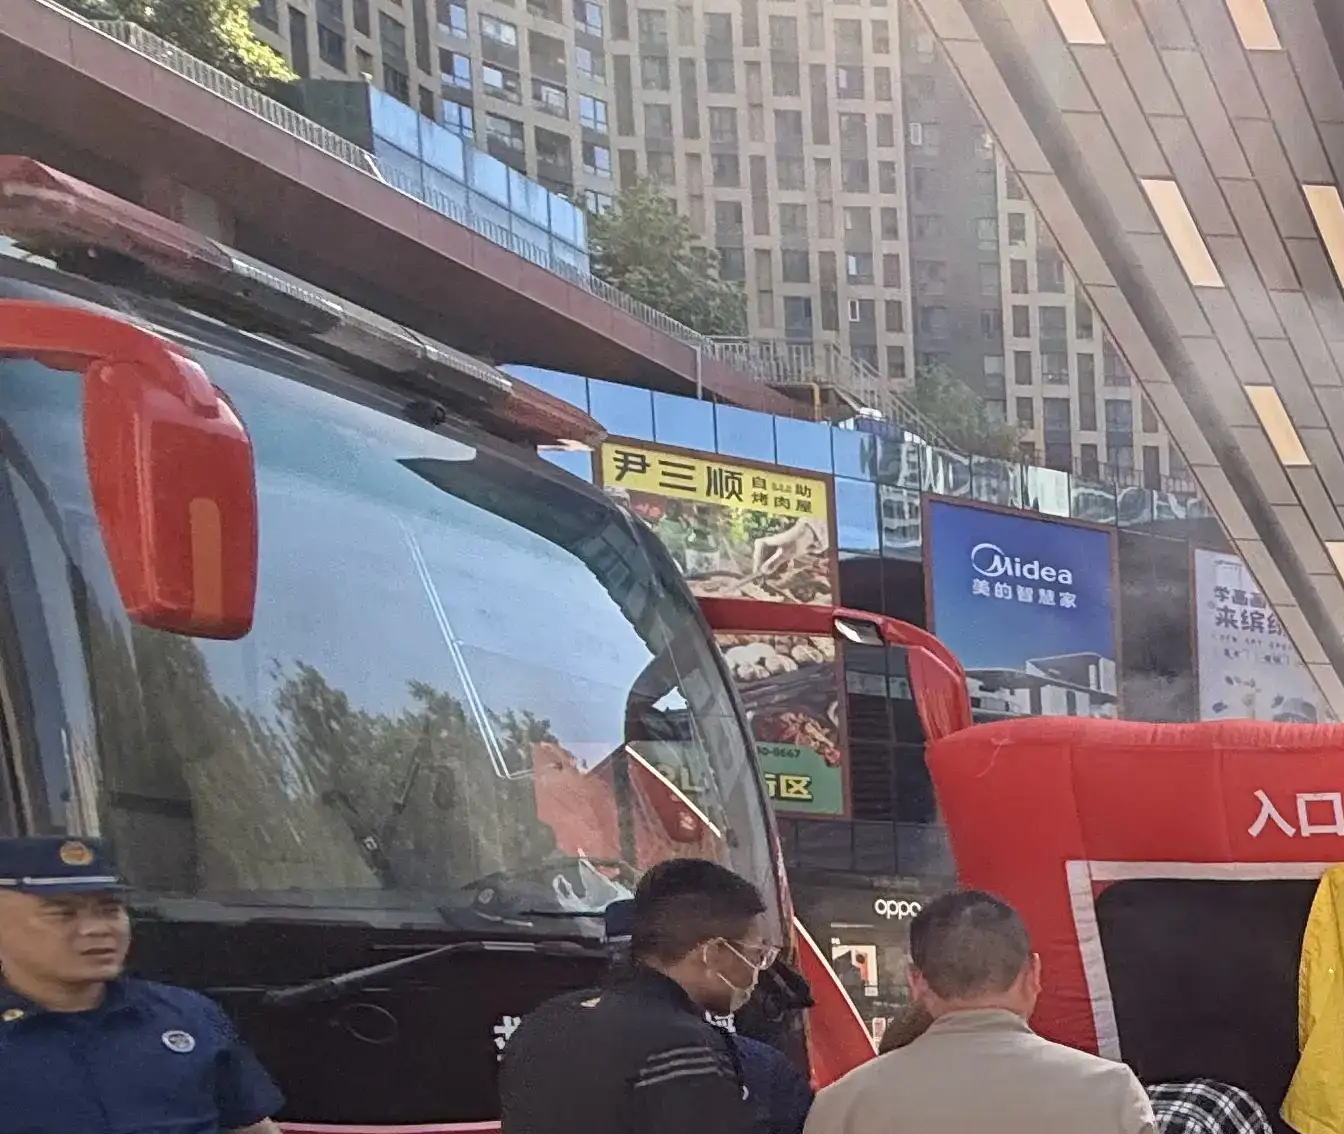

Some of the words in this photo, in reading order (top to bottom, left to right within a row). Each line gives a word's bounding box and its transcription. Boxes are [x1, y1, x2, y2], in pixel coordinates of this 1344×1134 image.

[613, 449, 744, 502] 尹三顺
[751, 491, 812, 513] 烤肉屋
[971, 543, 1073, 586] Midea
[972, 578, 1078, 609] 美的智慧家
